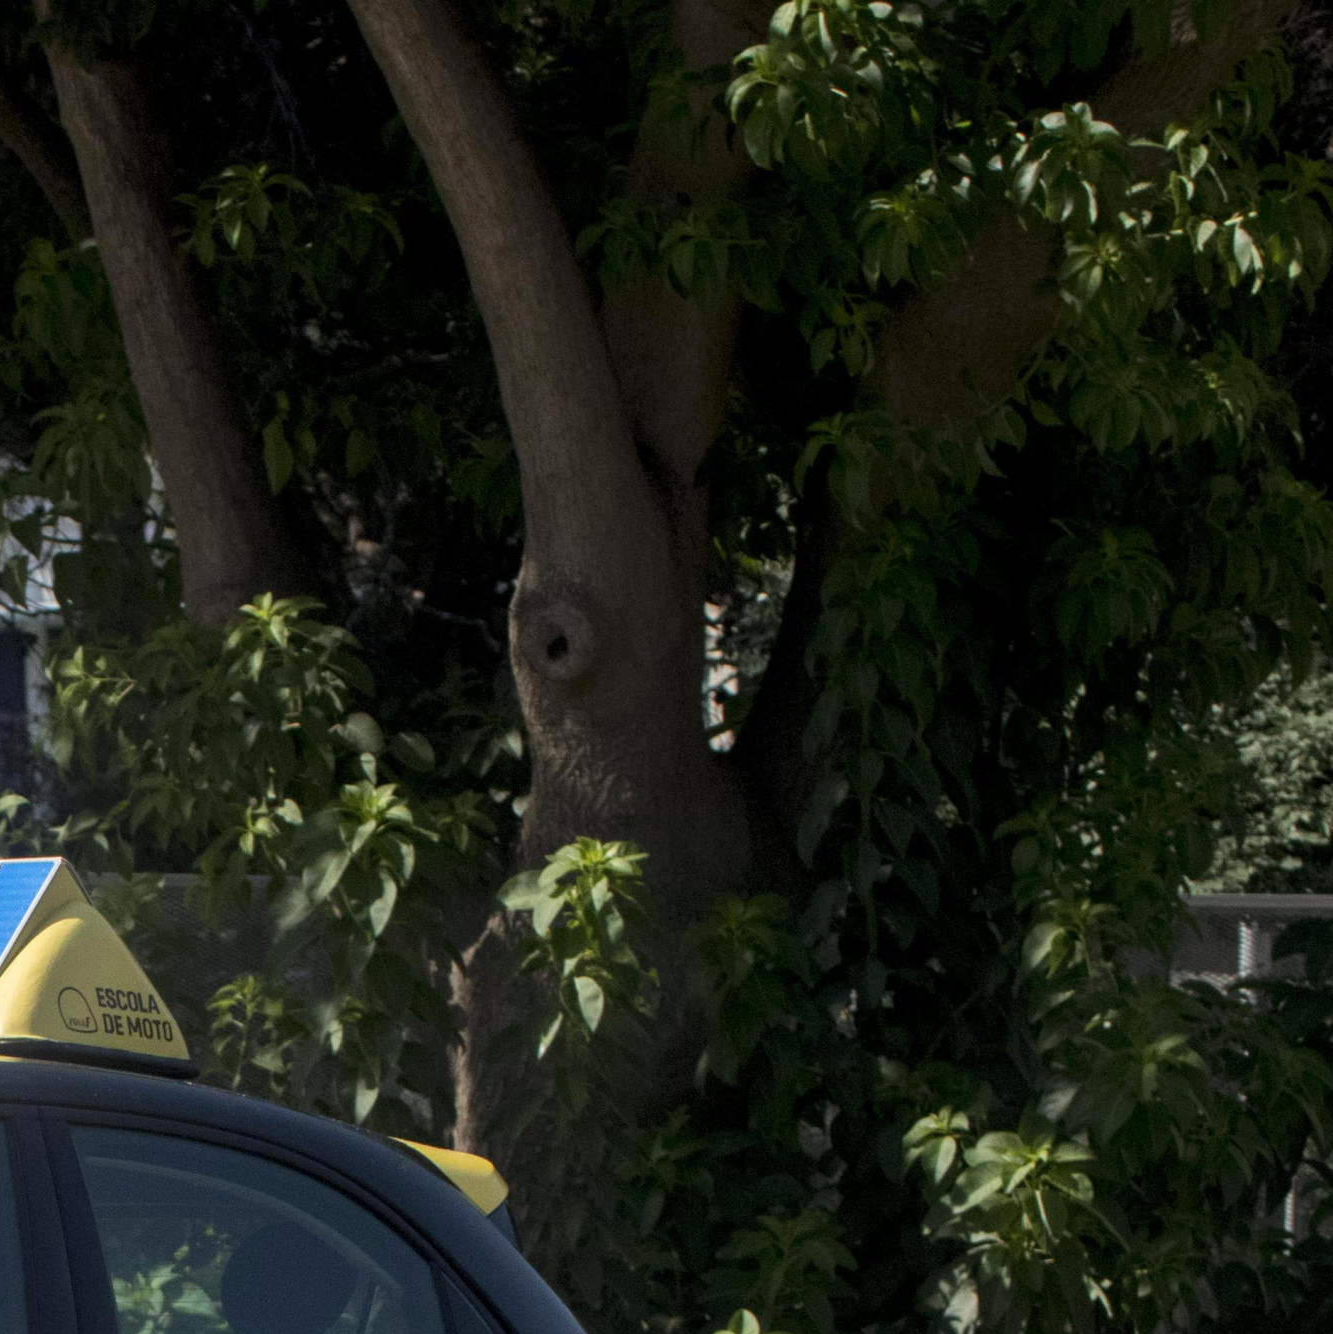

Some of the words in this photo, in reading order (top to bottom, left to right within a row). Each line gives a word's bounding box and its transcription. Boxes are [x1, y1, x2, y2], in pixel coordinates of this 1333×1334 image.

[95, 987, 161, 1014] ESCOLA
[102, 1013, 125, 1036] DE
[126, 1016, 174, 1042] MOTO
